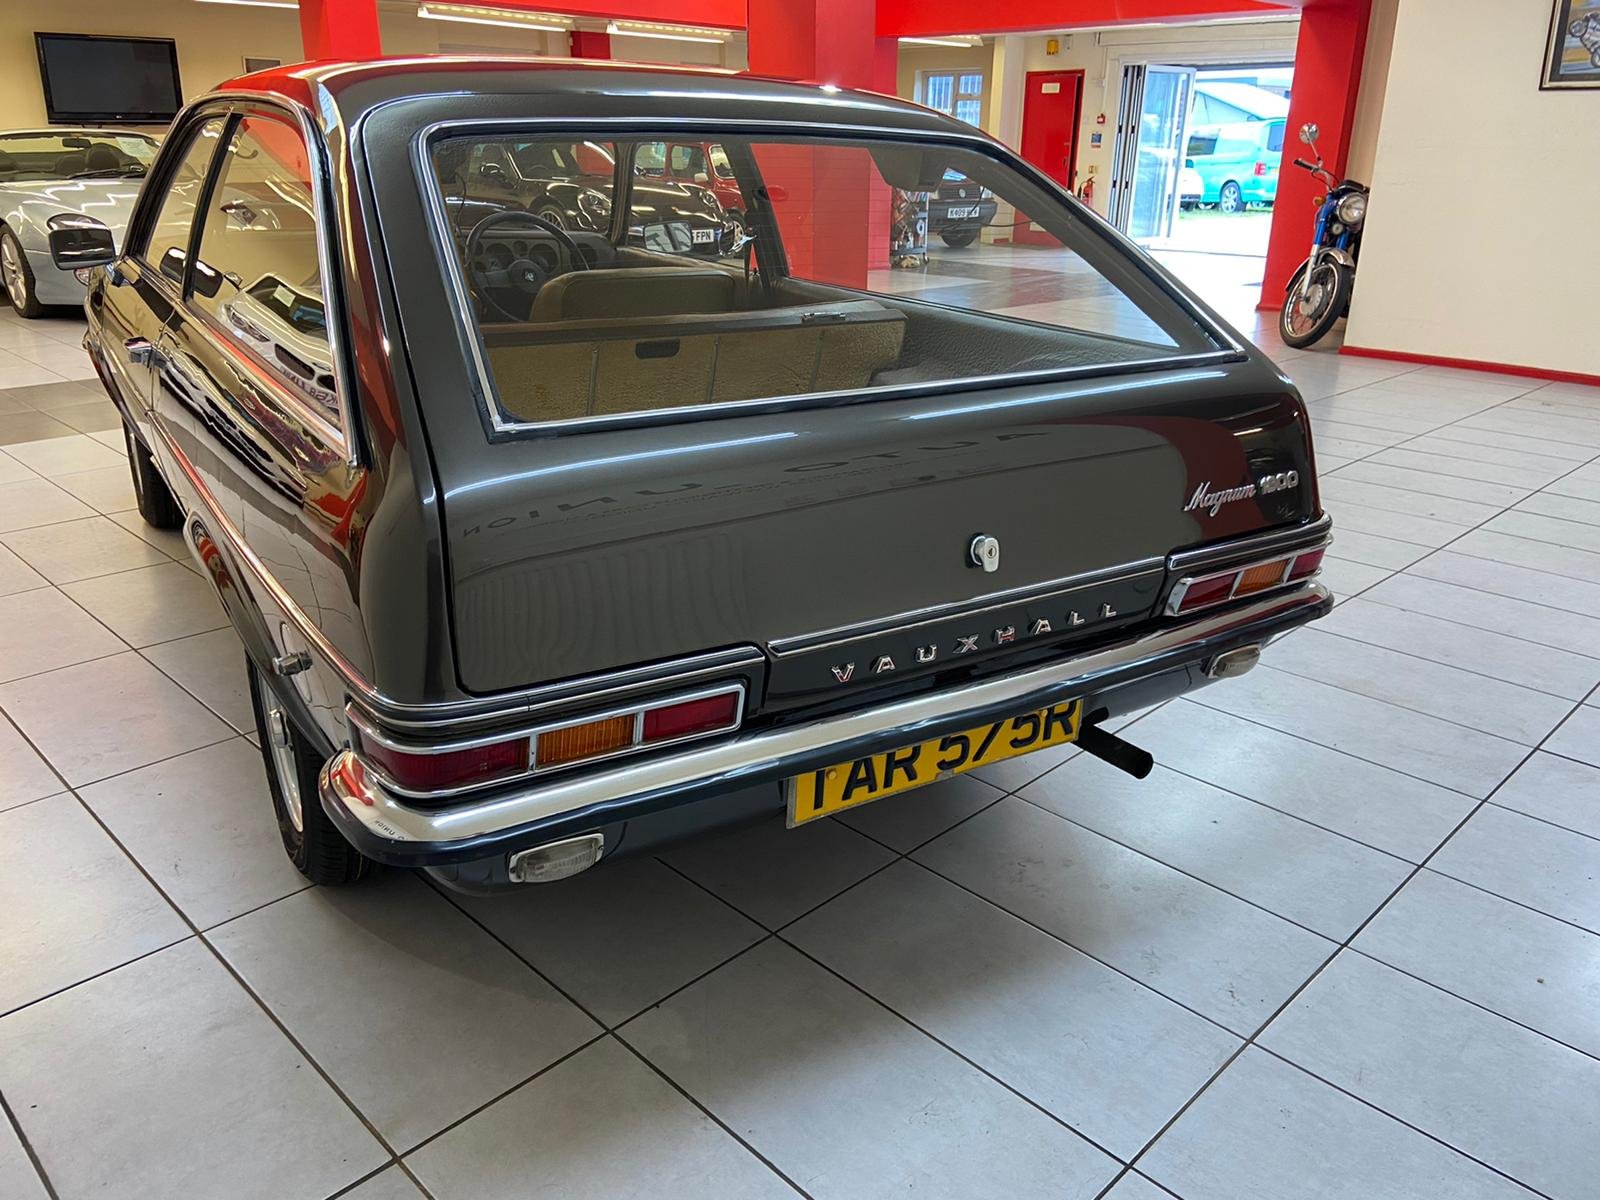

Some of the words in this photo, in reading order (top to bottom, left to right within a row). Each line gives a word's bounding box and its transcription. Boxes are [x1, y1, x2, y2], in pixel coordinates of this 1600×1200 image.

[695, 230, 711, 242] FPN
[1183, 480, 1257, 518] Magnum
[831, 602, 1117, 684] VAUXHALL
[936, 699, 1078, 771] 575R
